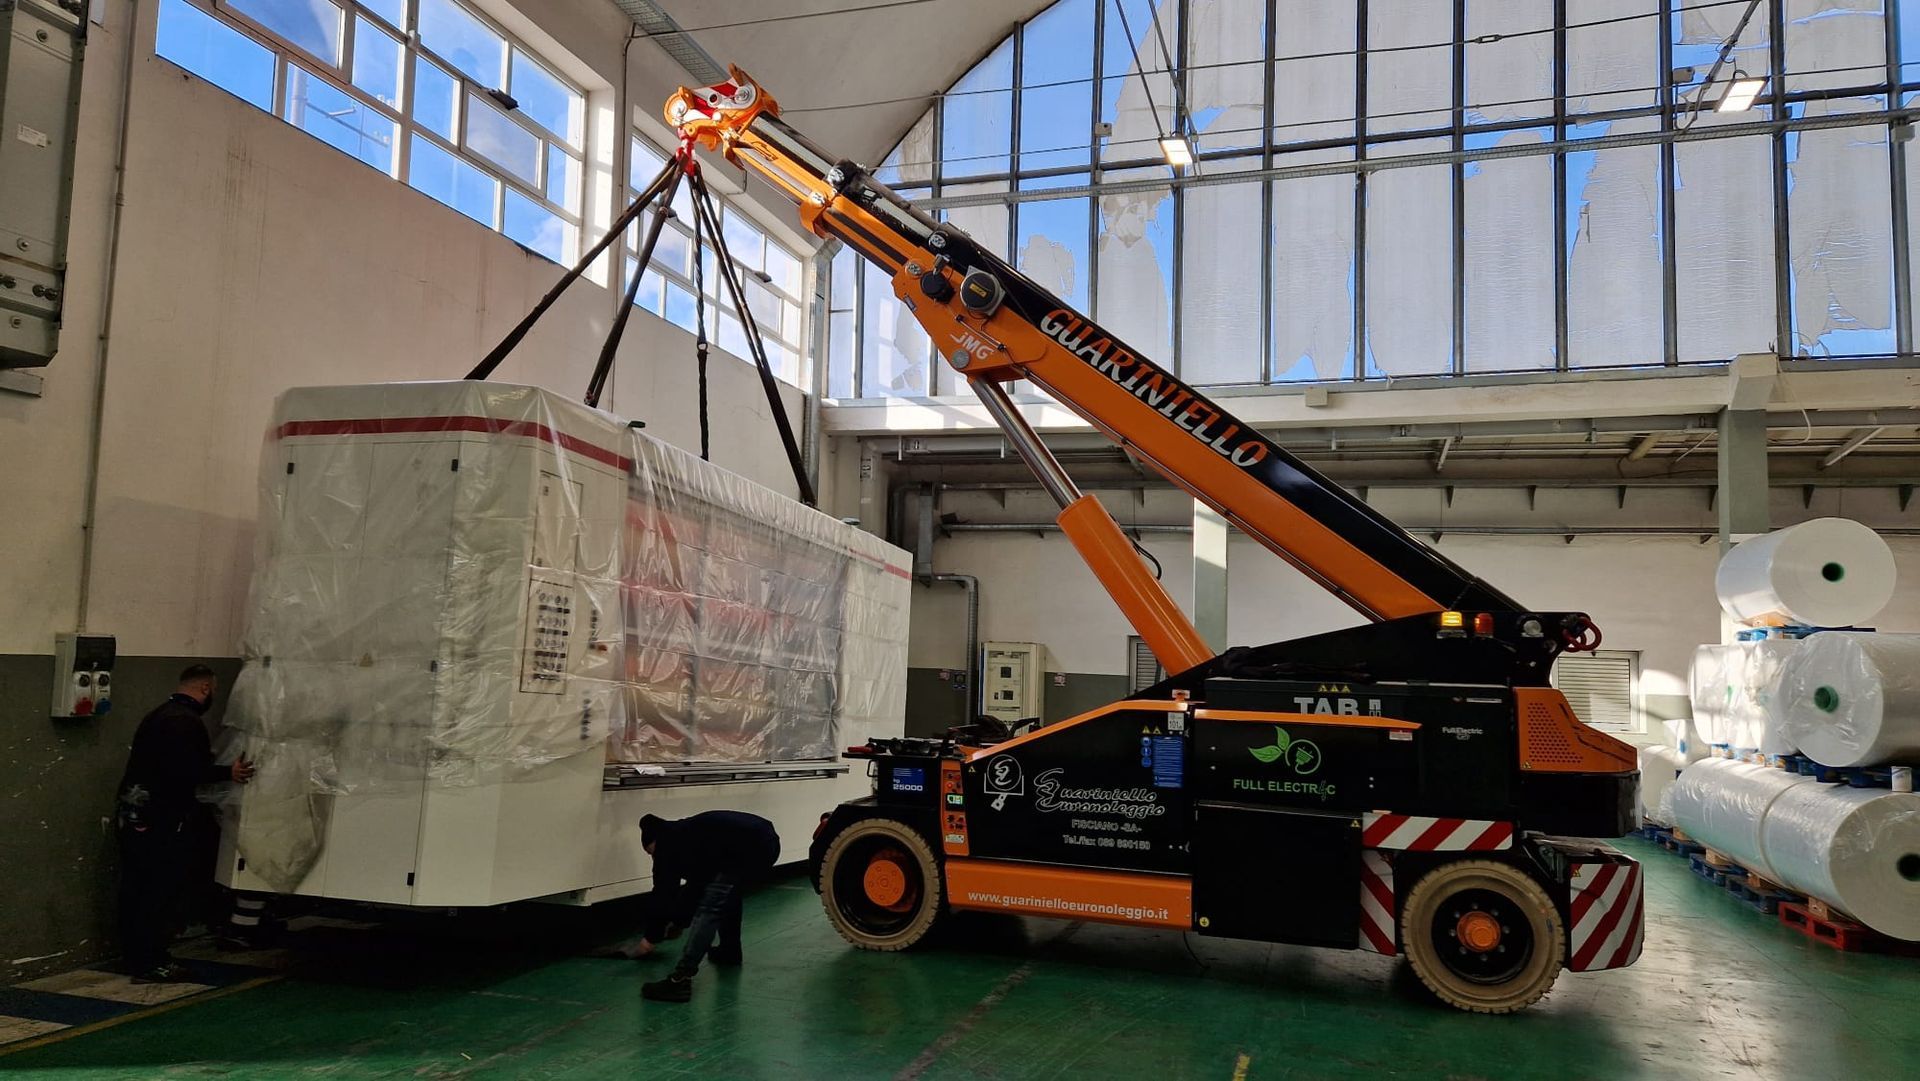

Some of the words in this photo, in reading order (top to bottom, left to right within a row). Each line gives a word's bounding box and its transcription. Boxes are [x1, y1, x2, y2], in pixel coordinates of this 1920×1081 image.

[1040, 309, 1268, 468] GUARINIELLO
[893, 783, 923, 792] 25000
[1033, 768, 1157, 802] Guariniello
[1035, 783, 1165, 818] Euronoleggio
[1233, 779, 1265, 791] FULL
[968, 891, 1169, 920] www.guarinielloeuronoleggio.it
